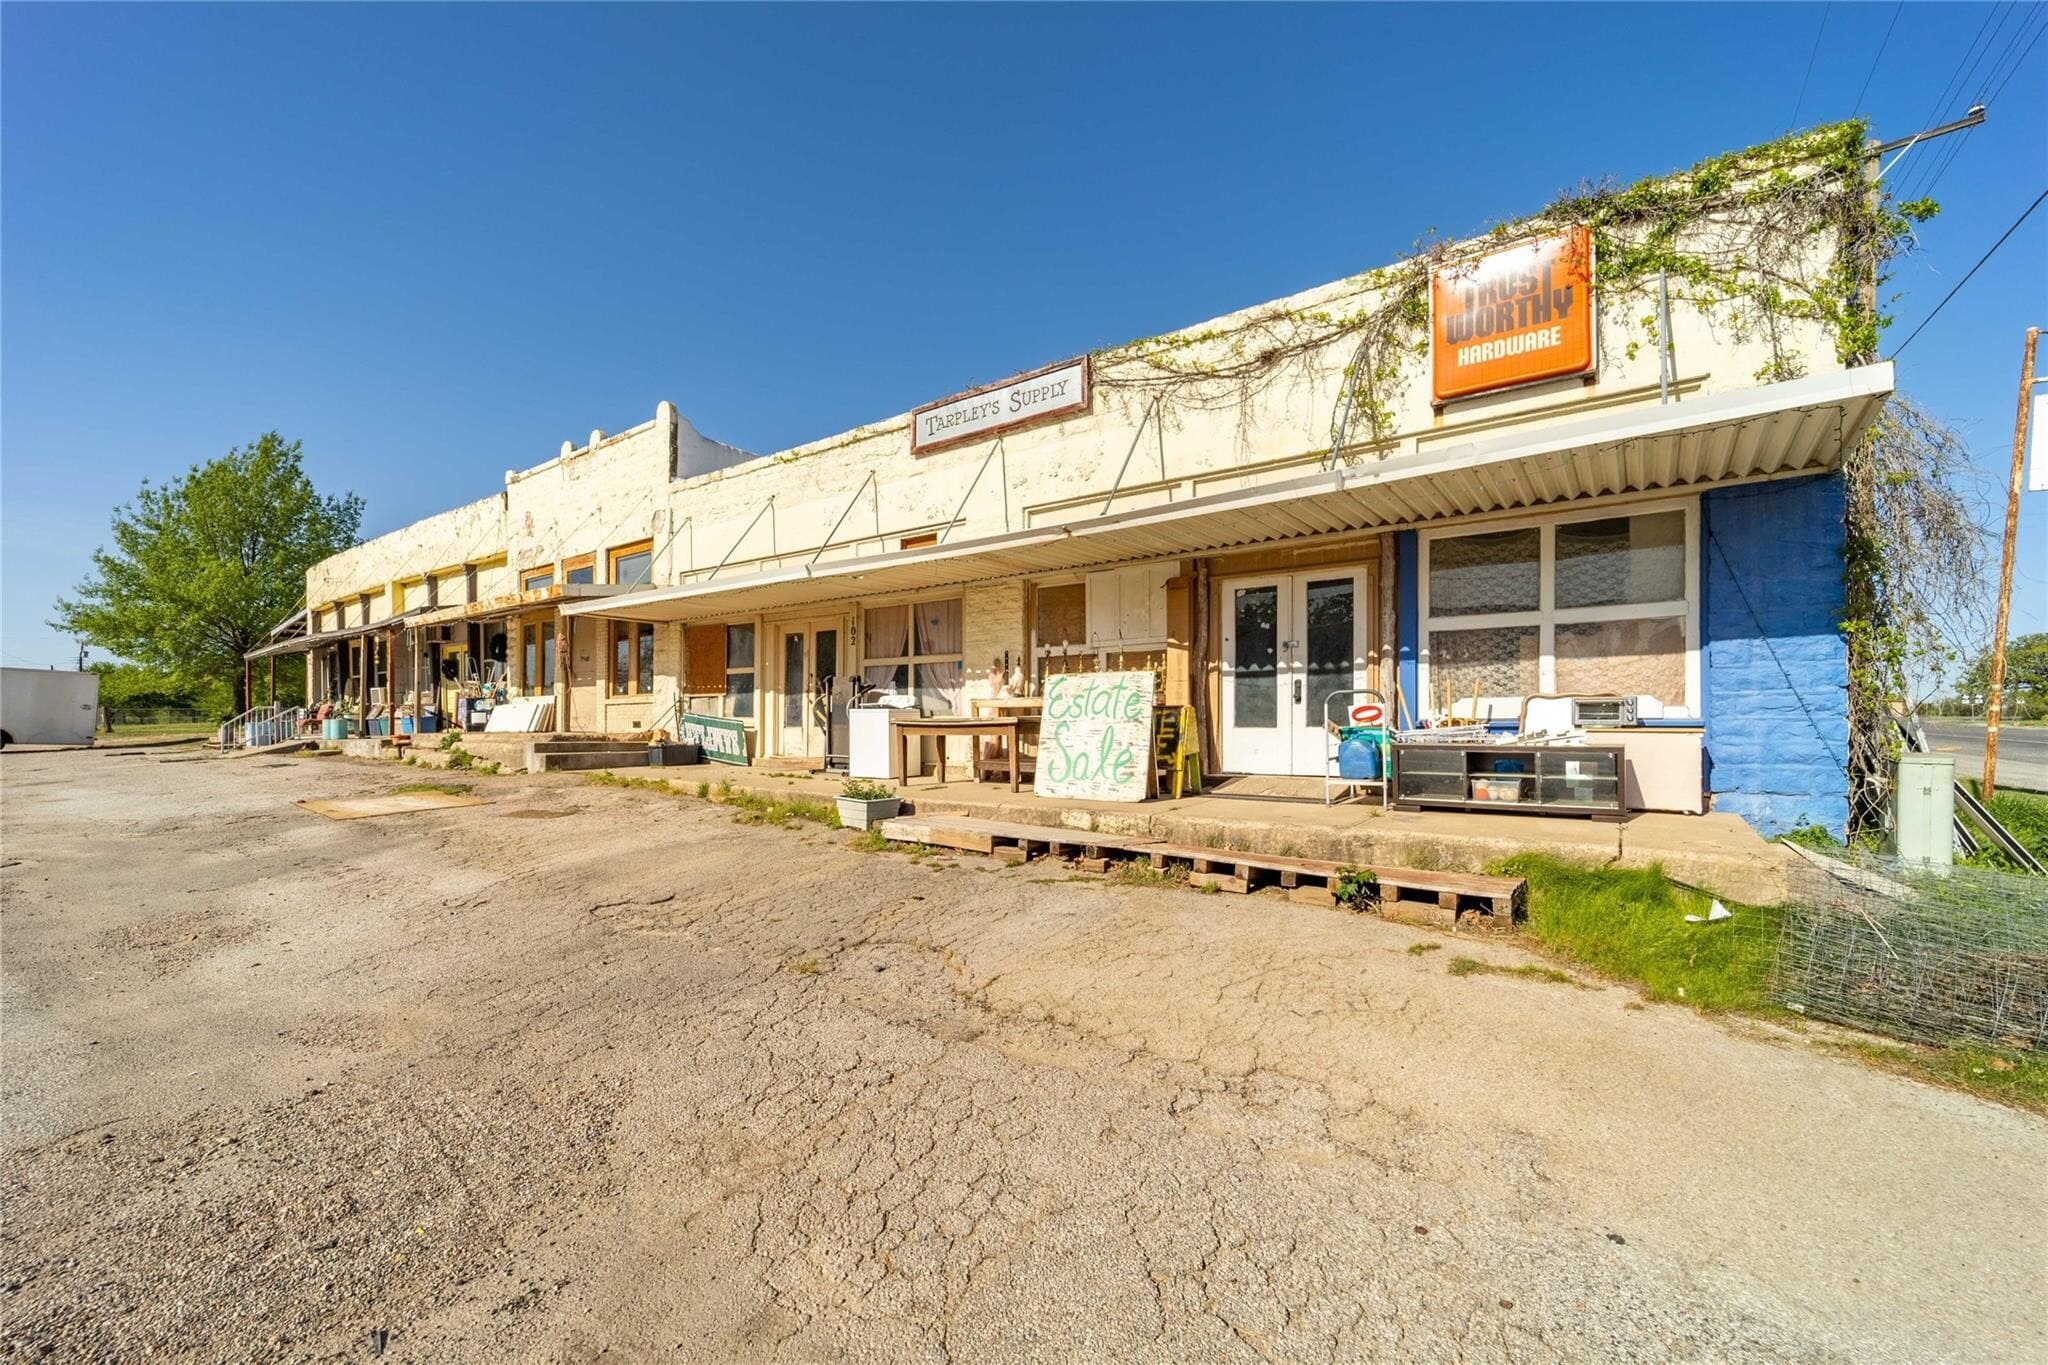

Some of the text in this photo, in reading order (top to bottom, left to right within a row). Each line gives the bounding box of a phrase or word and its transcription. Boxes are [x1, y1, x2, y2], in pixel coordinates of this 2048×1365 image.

[1460, 257, 1556, 308] TRUST
[1446, 286, 1573, 345] WORTHY
[1457, 325, 1562, 368] HARDWARE
[925, 379, 1069, 437] TARPLEY'S SUPPLY
[1048, 676, 1143, 720] Estate
[1047, 721, 1134, 785] Sale
